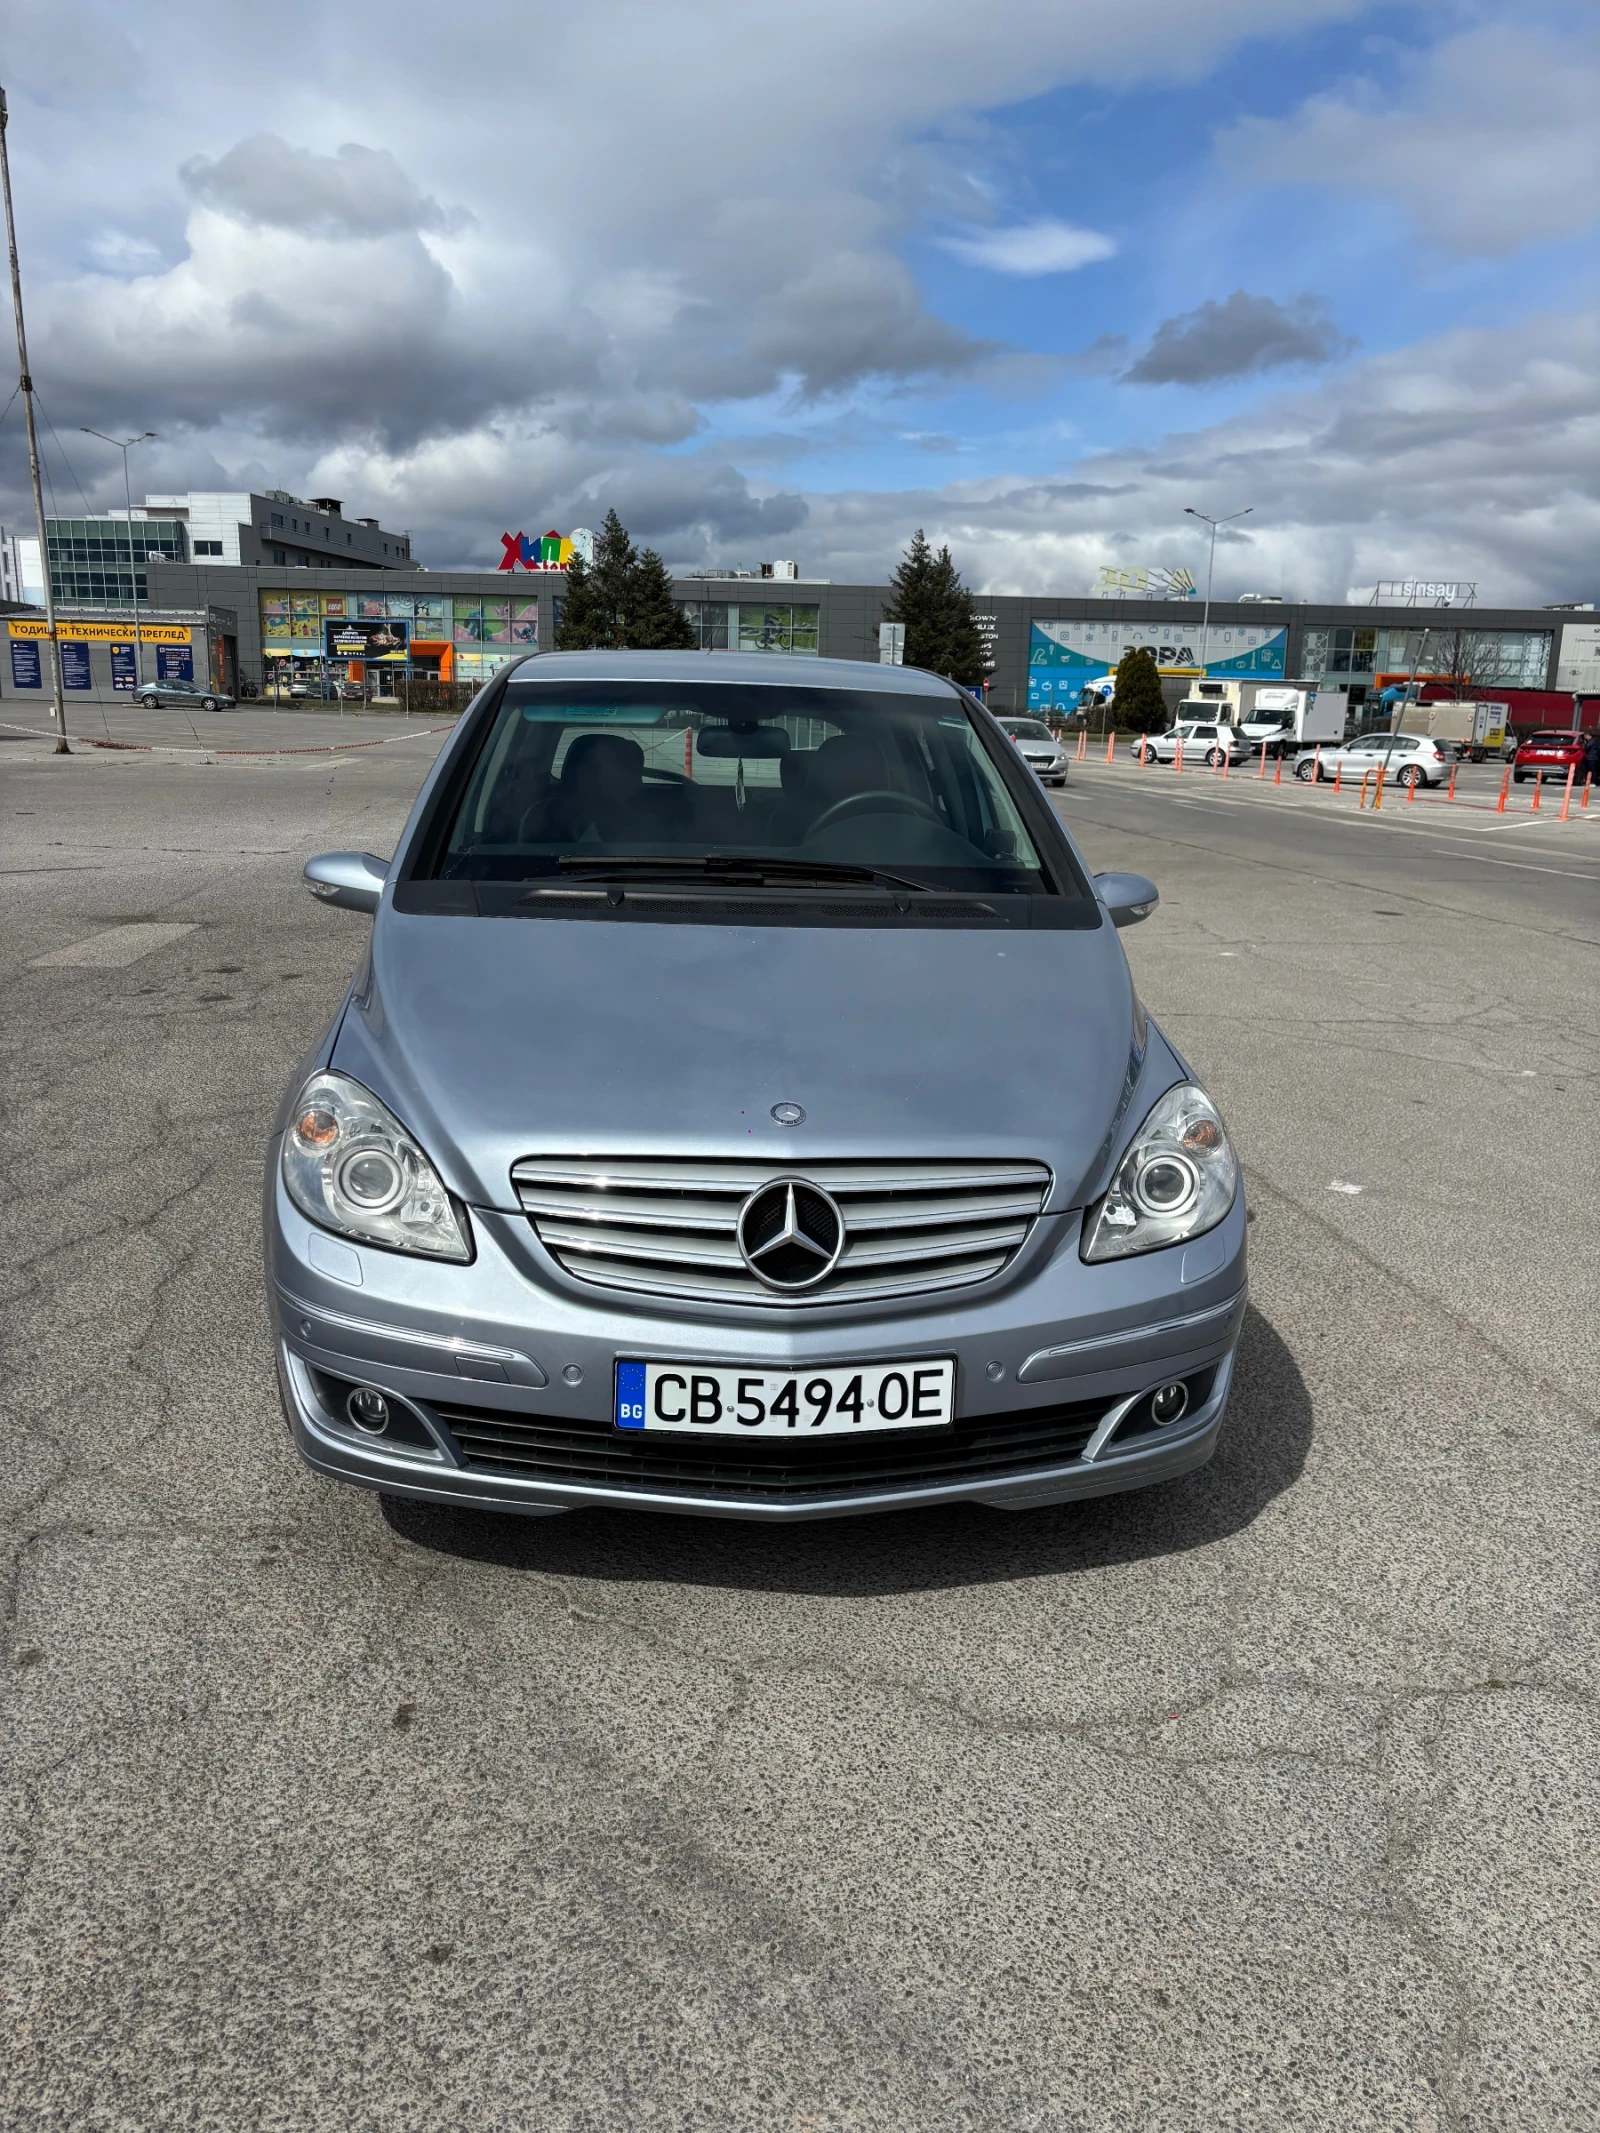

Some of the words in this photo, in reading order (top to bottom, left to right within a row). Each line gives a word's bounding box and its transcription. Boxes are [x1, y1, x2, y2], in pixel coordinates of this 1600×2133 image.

[1092, 566, 1197, 594] ЗОРА
[1402, 580, 1456, 602] sinsay
[327, 603, 342, 611] LEGO
[70, 627, 137, 637] ТЕХНИЧЕСКИ
[139, 629, 186, 640] ПРЕГЛЕД
[653, 1373, 723, 1425] CB
[736, 1374, 865, 1428] 5494
[620, 1403, 643, 1419] BG
